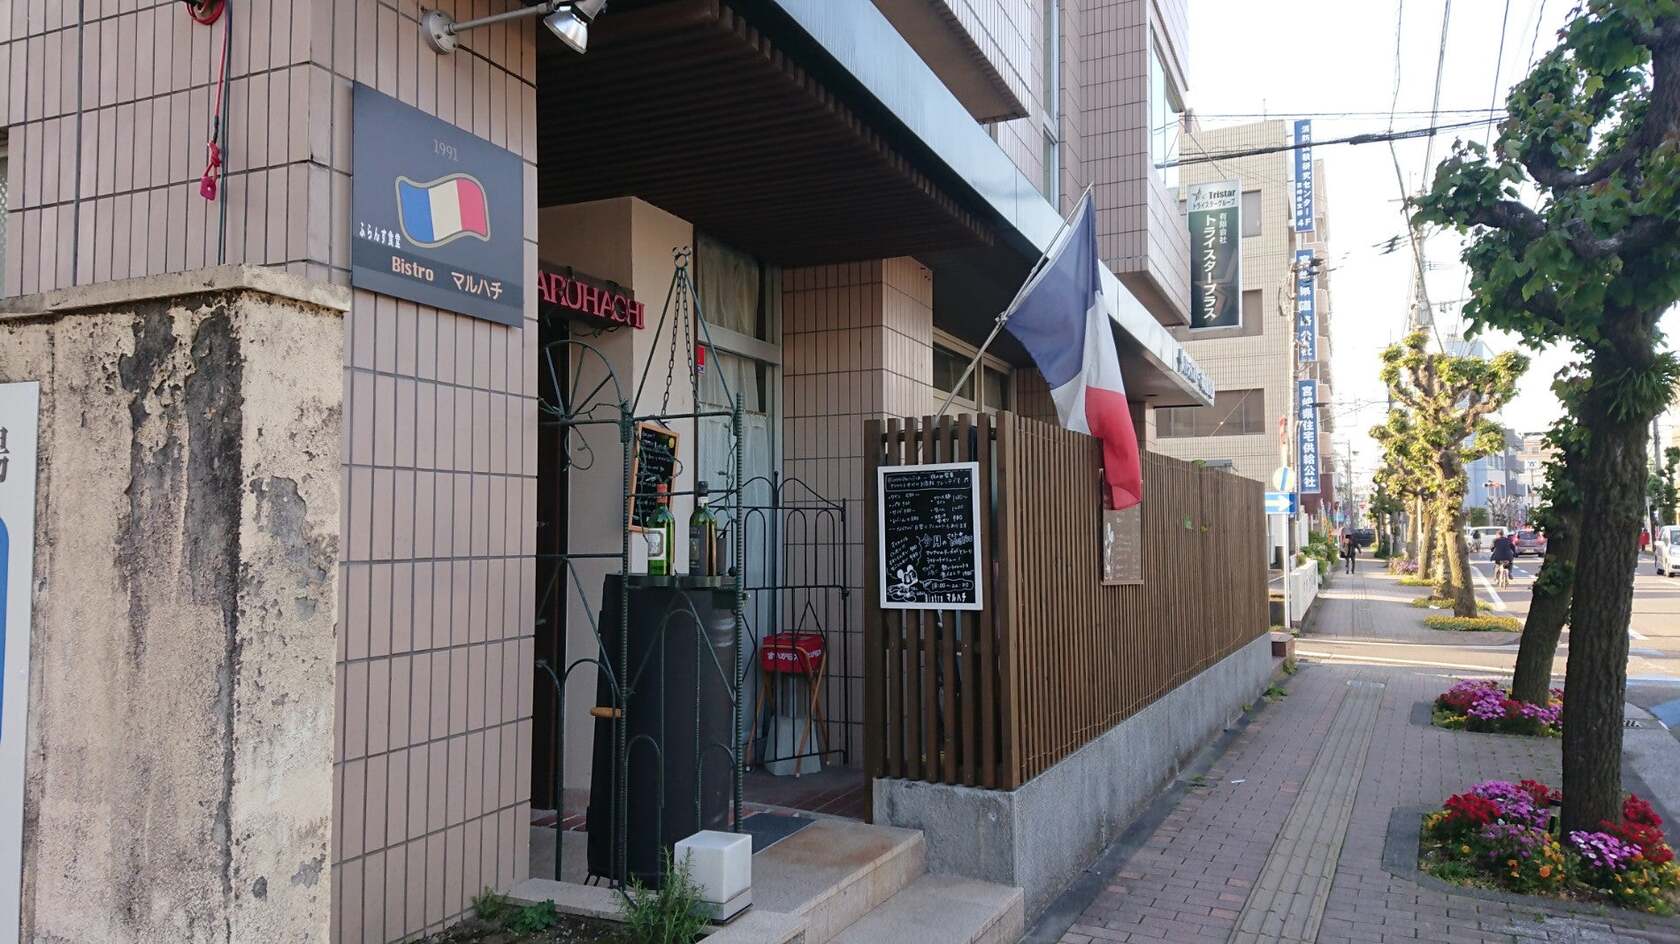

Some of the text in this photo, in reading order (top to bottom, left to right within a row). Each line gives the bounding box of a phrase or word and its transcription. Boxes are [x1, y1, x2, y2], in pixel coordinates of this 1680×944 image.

[433, 138, 459, 163] 1991
[1208, 189, 1237, 200] Tristar
[359, 221, 401, 249] ふらんす食堂
[391, 256, 503, 300] Bistro マルハチ
